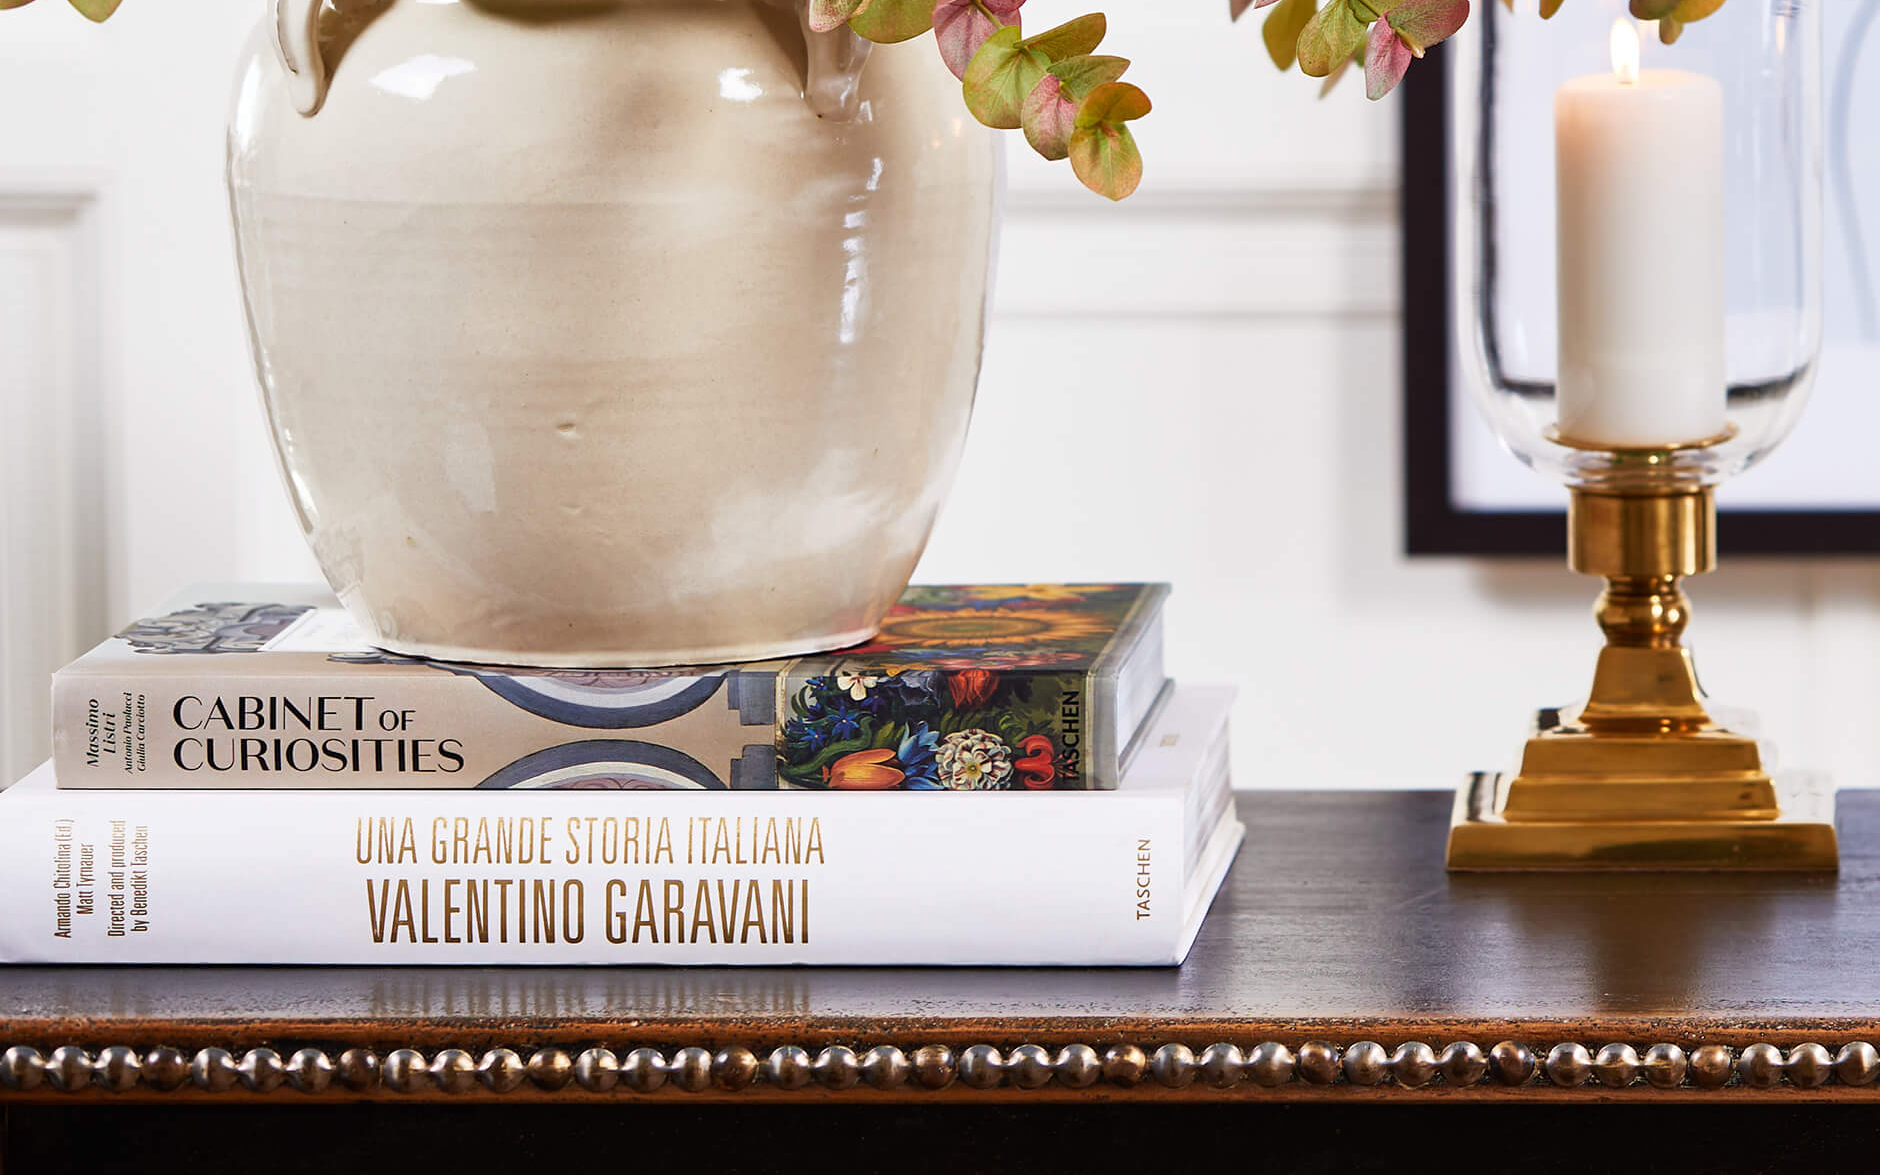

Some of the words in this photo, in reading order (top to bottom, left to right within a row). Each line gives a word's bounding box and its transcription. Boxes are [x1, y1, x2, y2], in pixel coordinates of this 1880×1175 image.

[86, 698, 100, 768] Massimo
[102, 712, 116, 754] Listri
[122, 691, 133, 735] Paolucci
[135, 694, 146, 741] Carciotto
[172, 695, 376, 731] CABINET
[378, 709, 417, 732] OF
[122, 736, 134, 775] Antonio
[136, 743, 146, 772] Giulia
[172, 737, 465, 773] CURIOSITIES
[1061, 690, 1080, 781] TASCHEN
[107, 819, 127, 868] produced
[129, 825, 149, 866] Taschen
[356, 816, 418, 865] UNA
[431, 816, 553, 865] GRANDE
[565, 816, 674, 865] STORIA
[687, 816, 825, 865] ITALIANA
[52, 844, 71, 889] Chitolina
[76, 843, 96, 888] Tyrnauer
[107, 871, 125, 891] and
[1136, 839, 1151, 921] TASCHEN
[76, 890, 94, 915] Matt
[107, 893, 126, 937] Directed
[129, 870, 149, 916] Benedikt
[366, 878, 585, 944] VALENTINO
[605, 878, 809, 944] GARAVANI
[53, 892, 72, 939] Armando
[129, 919, 150, 932] by
